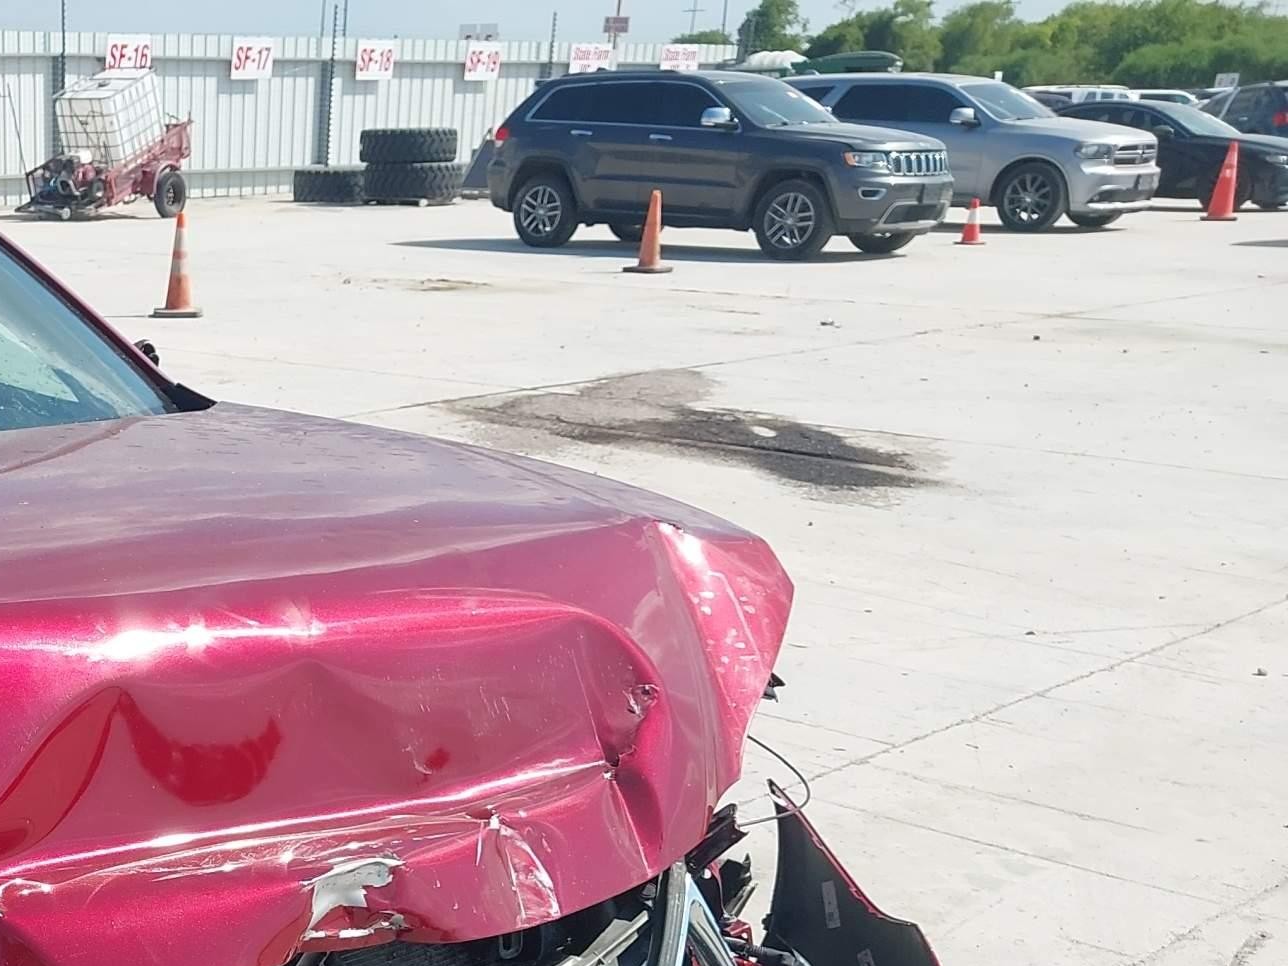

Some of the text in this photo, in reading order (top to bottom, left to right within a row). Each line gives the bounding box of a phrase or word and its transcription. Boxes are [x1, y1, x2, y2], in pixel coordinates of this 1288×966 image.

[108, 44, 150, 69] SF-16
[234, 46, 272, 71] SF-17
[359, 48, 393, 71] SF-18
[467, 50, 501, 73] SF-19
